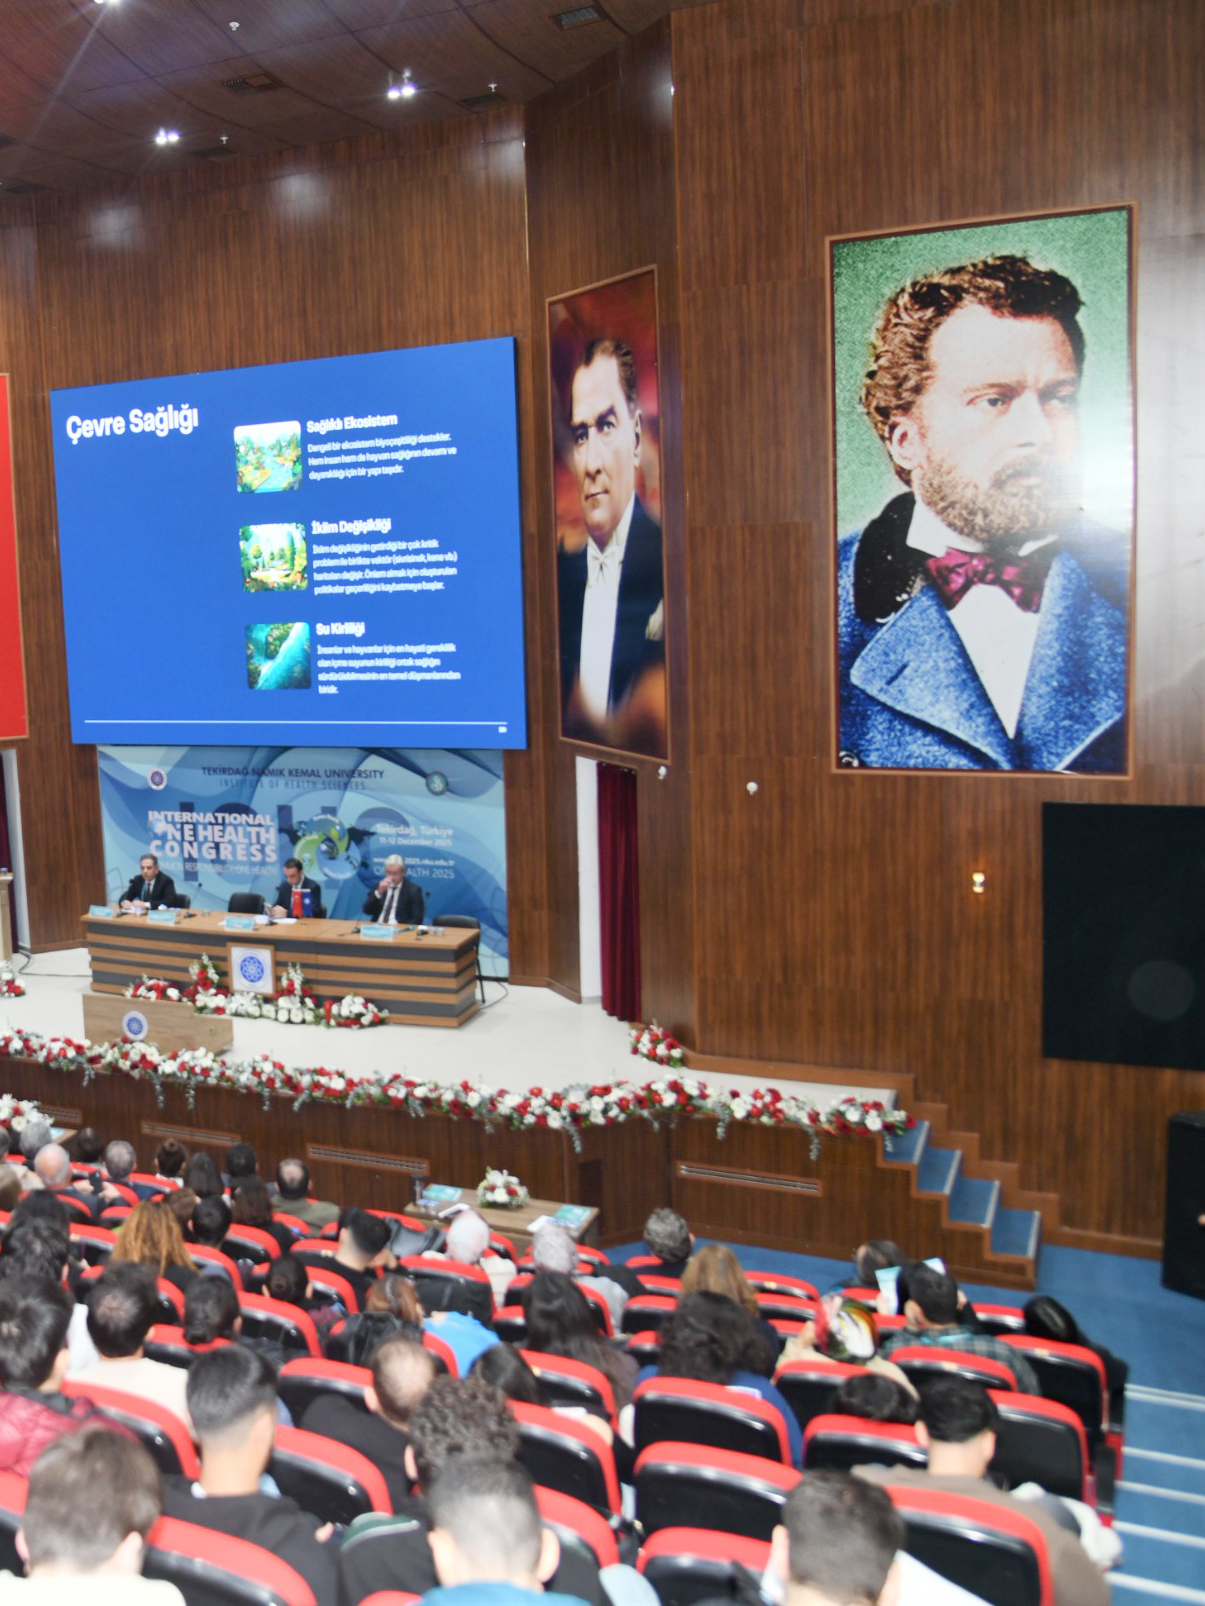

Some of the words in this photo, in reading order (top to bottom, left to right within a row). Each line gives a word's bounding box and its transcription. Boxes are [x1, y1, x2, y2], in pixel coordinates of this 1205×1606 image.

[66, 415, 126, 444] Çevre
[129, 403, 199, 437] Sağlığı
[306, 417, 343, 435] Sağlıklı
[343, 414, 399, 430] Ekosistem
[311, 520, 338, 535] İklim
[338, 517, 392, 536] Değişikliği
[315, 623, 331, 636] Su
[330, 621, 366, 637] Kirliliği
[252, 767, 285, 777] NAMIK
[288, 768, 322, 778] KEMAL
[324, 768, 384, 779] UNIVERSITY
[270, 779, 280, 788] OF
[284, 779, 317, 789] HEALTH
[321, 780, 365, 790] SCIENCES
[148, 810, 274, 826] INTERNATIONAL
[198, 824, 275, 845] HEALTH
[419, 825, 454, 837] Türkiye
[397, 837, 433, 846] December
[150, 840, 278, 863] CONGRESS
[431, 868, 455, 879] 2025
